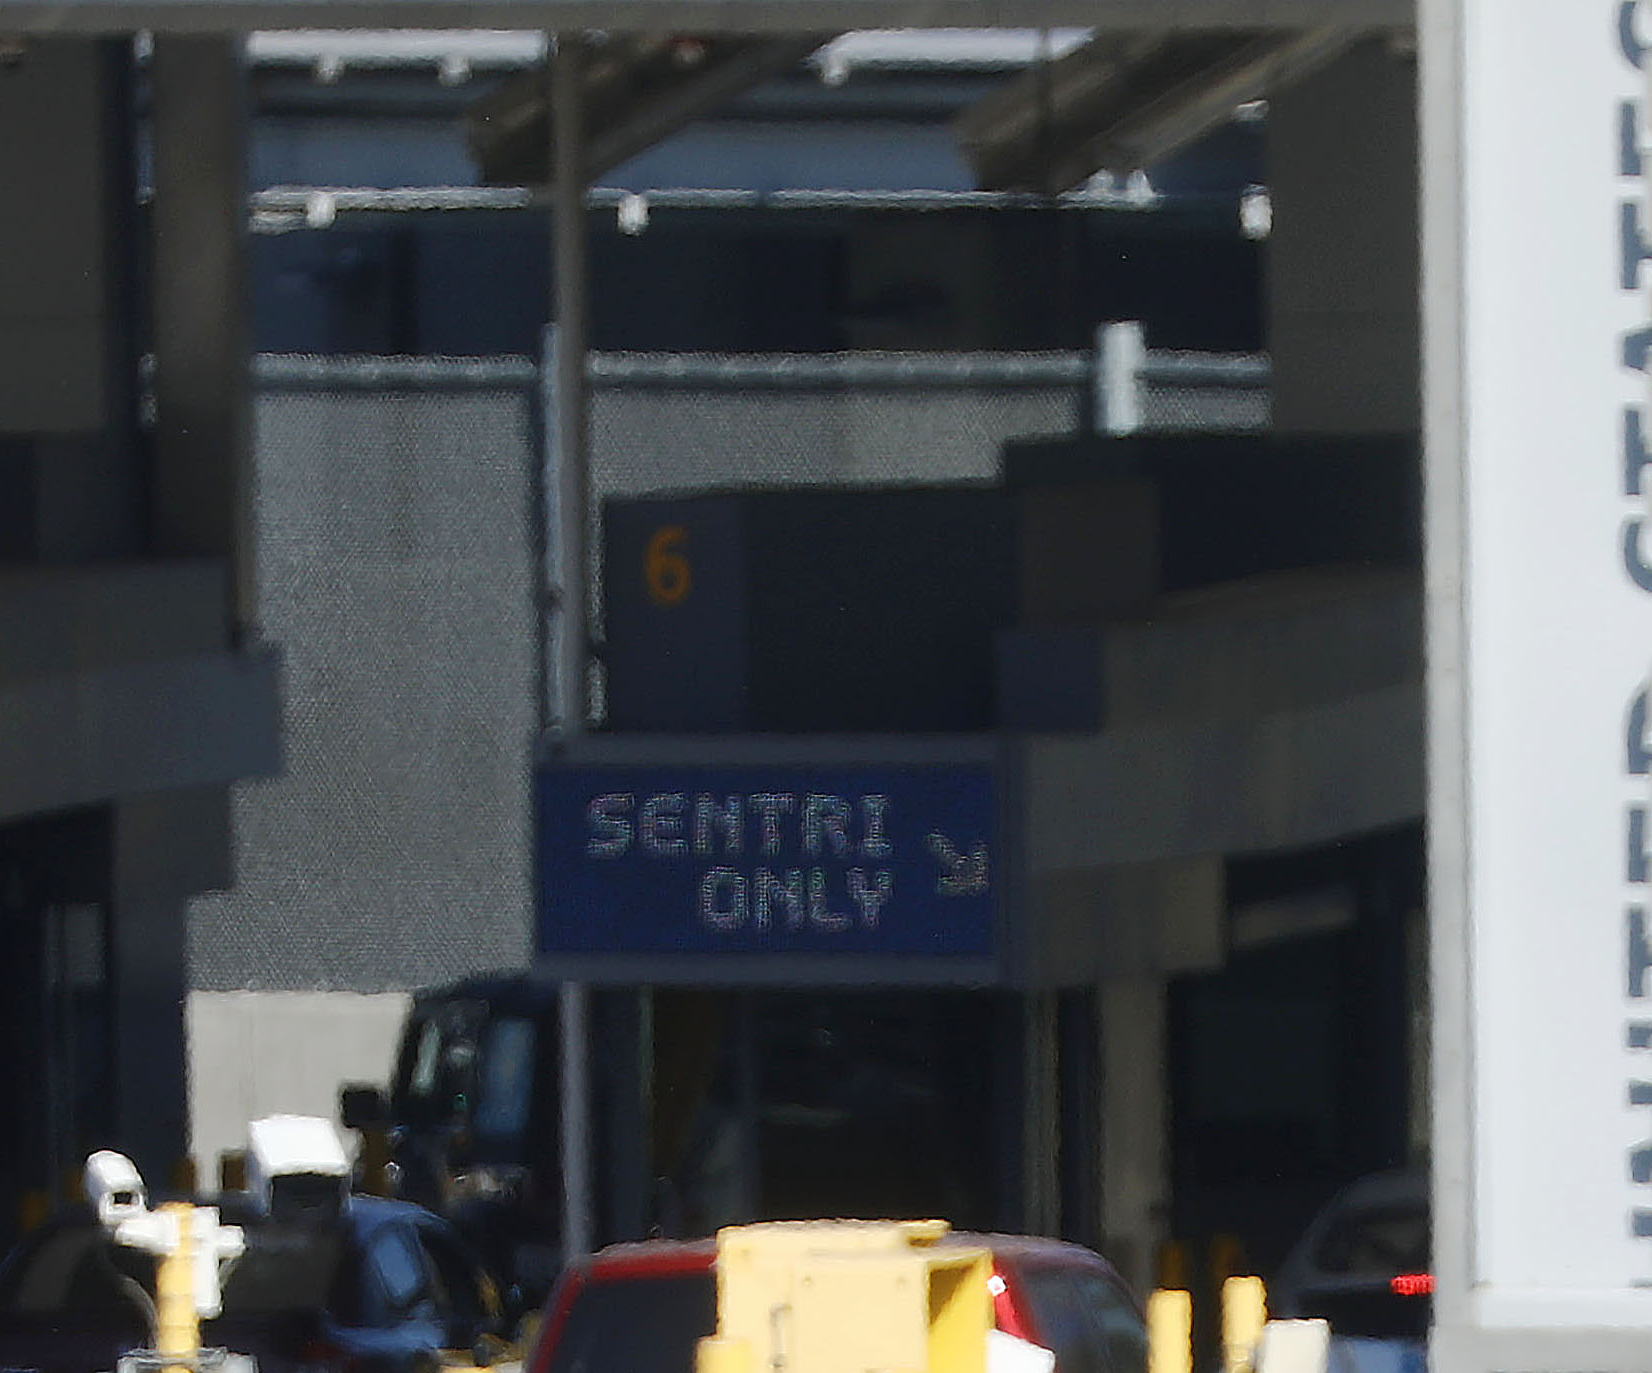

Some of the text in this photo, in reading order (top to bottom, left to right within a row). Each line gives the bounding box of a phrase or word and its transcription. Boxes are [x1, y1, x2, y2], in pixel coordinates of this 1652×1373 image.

[644, 526, 692, 606] 6
[584, 792, 893, 858] SENTRI
[700, 866, 895, 933] ONLY
